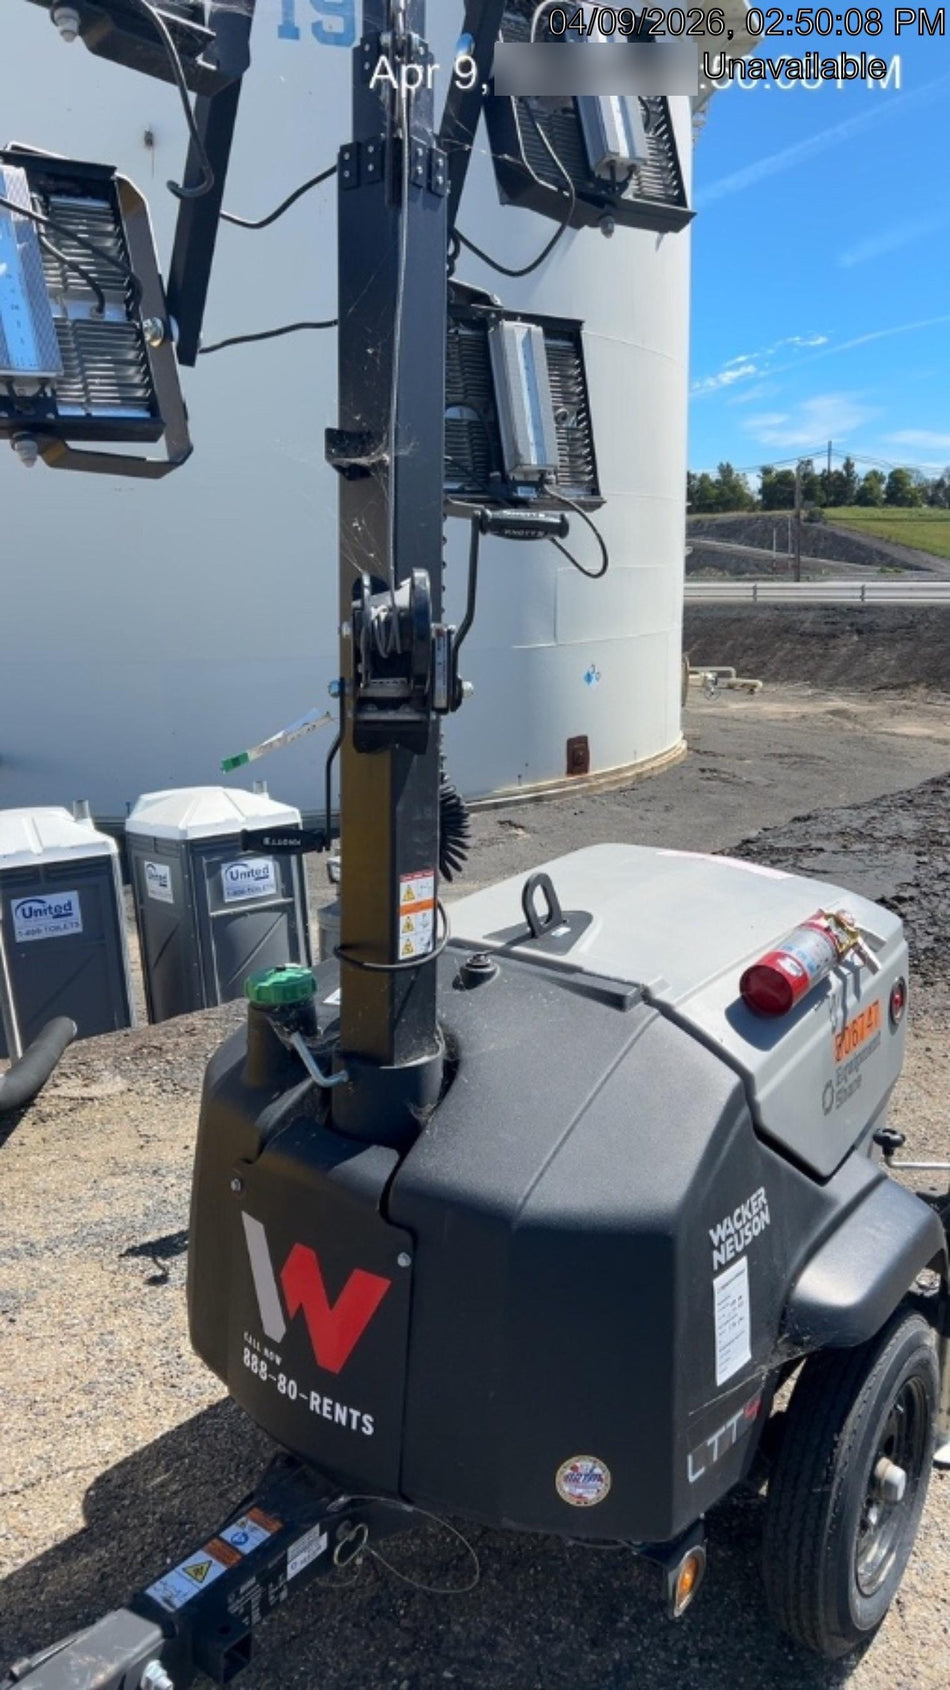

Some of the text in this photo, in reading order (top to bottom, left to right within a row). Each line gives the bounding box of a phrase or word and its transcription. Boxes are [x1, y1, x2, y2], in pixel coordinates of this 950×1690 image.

[231, 864, 269, 881] United
[22, 900, 72, 919] United
[708, 1186, 767, 1247] WACKER
[713, 1204, 771, 1271] NEUSON
[243, 1346, 375, 1436] 888-80-RENTS
